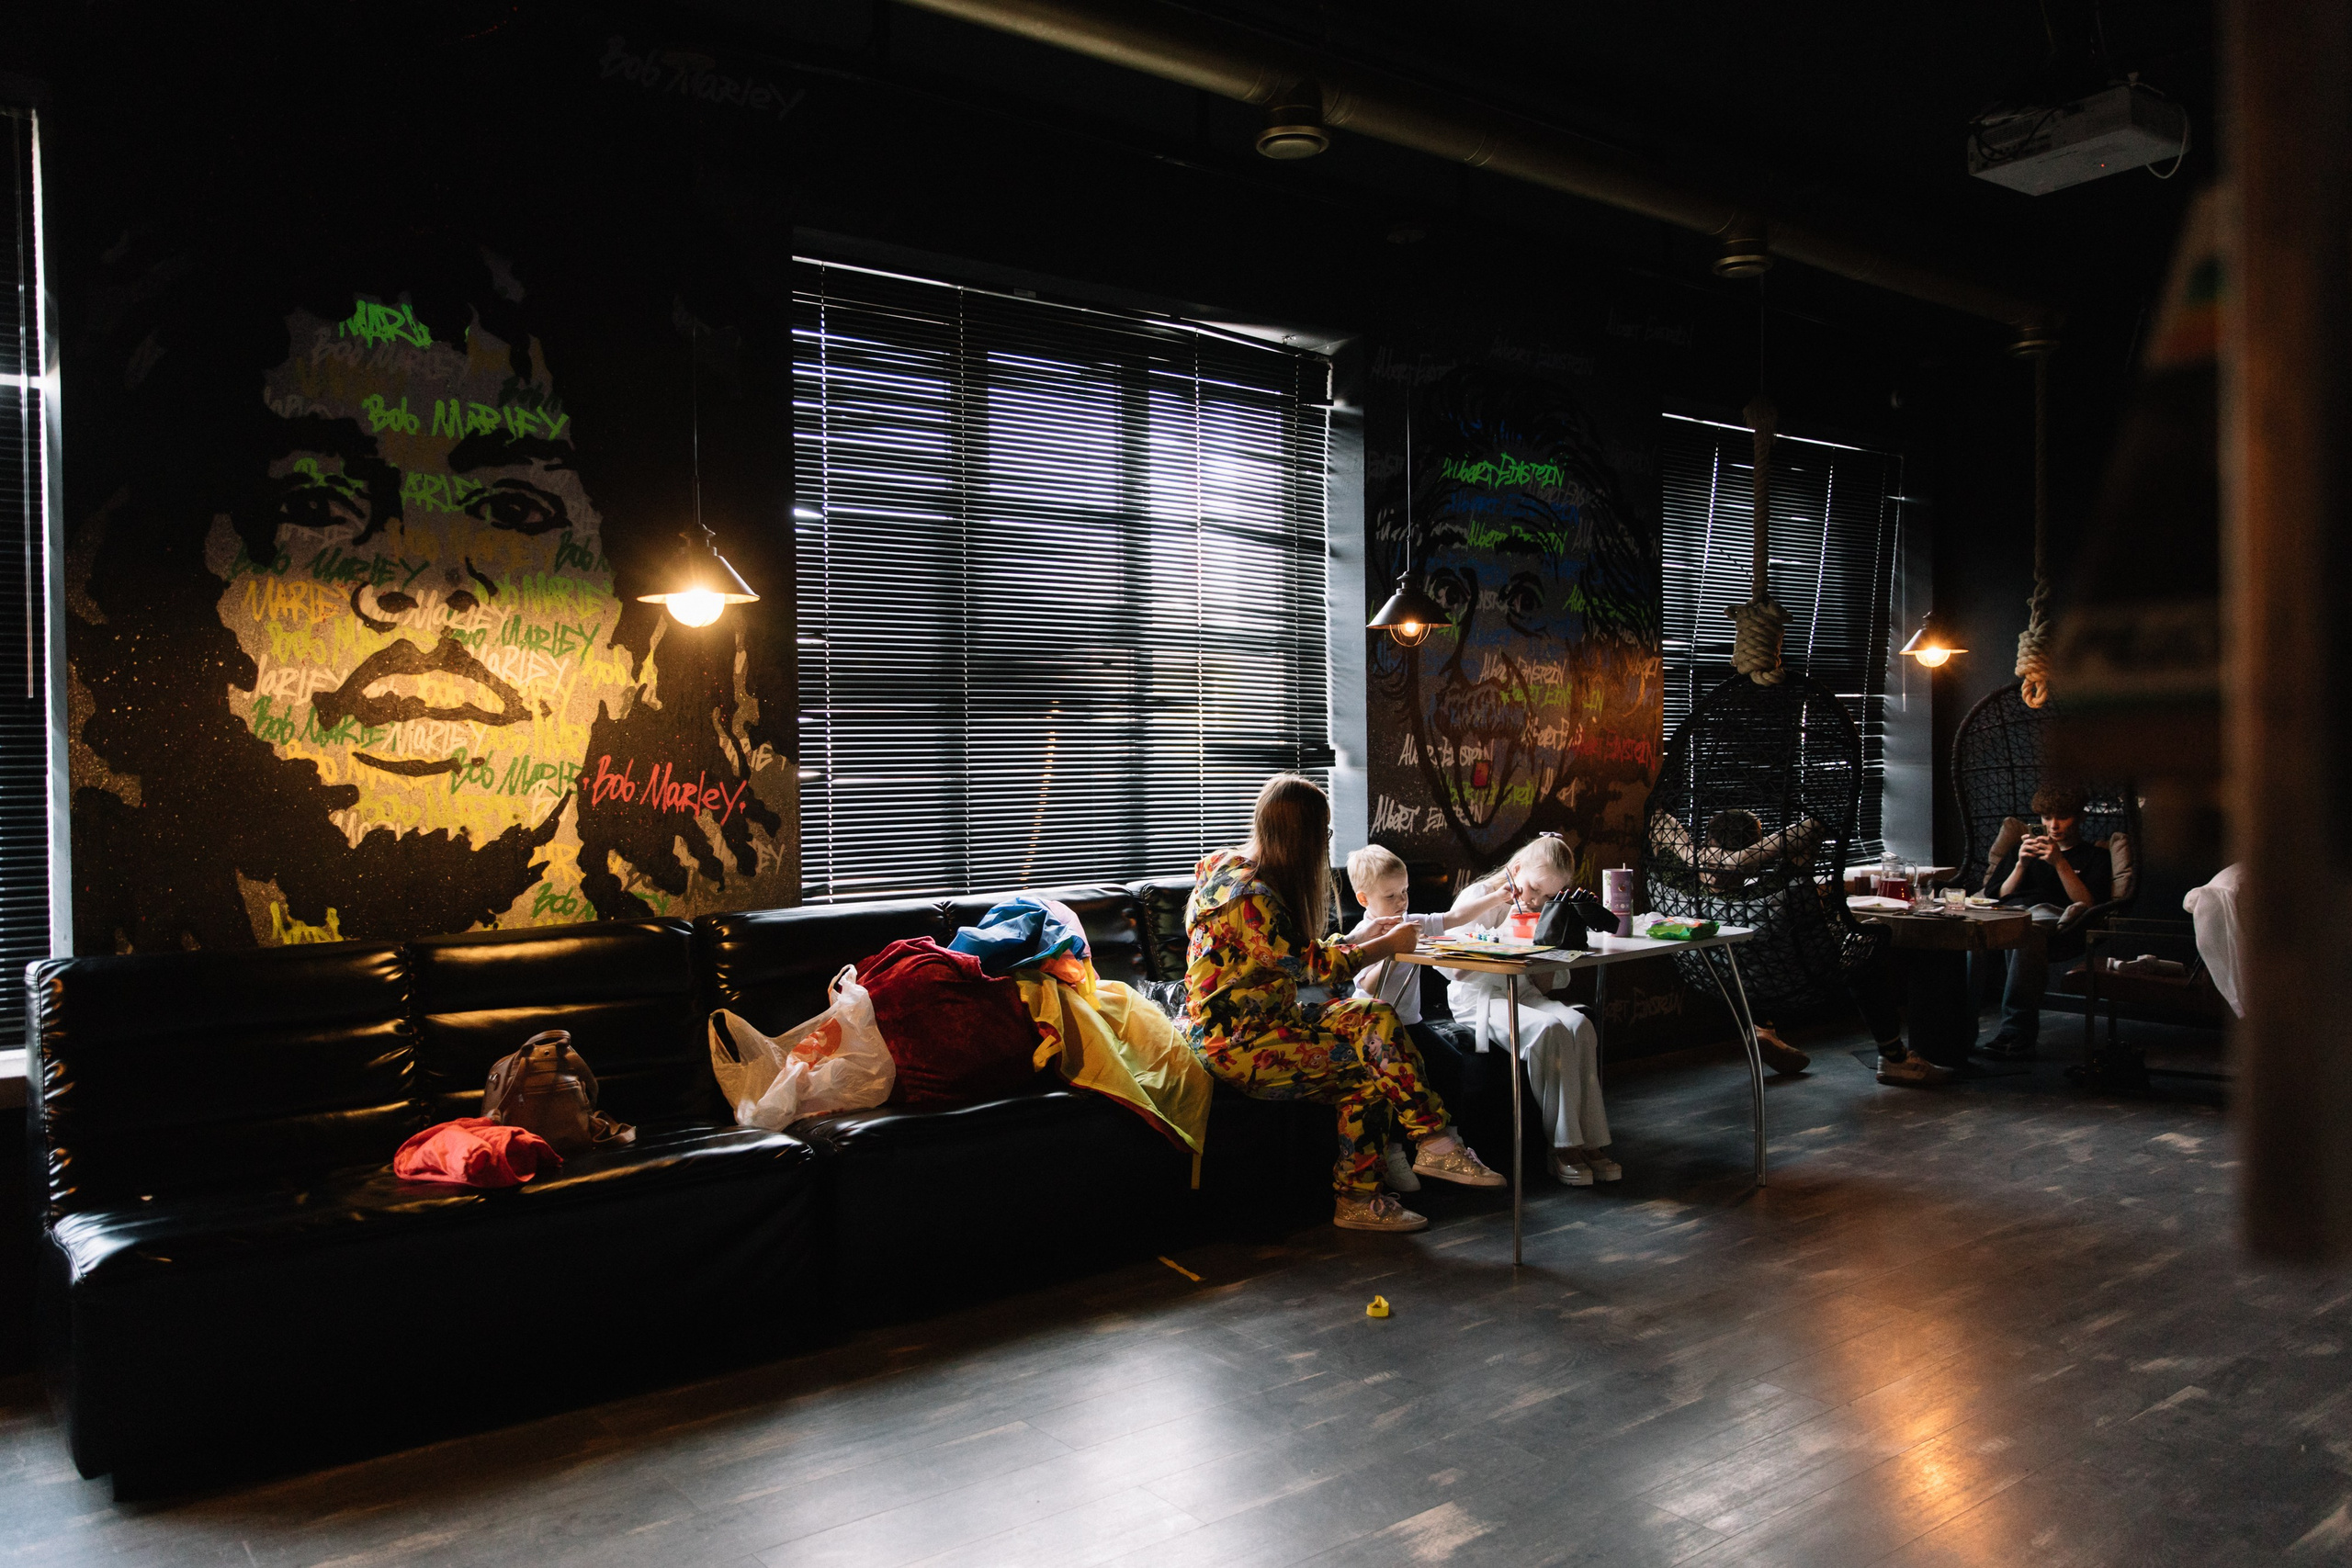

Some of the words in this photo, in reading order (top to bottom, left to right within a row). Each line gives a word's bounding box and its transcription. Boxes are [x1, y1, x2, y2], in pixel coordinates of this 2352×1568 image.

[599, 35, 662, 88] Bob
[362, 392, 421, 437] Bob
[502, 614, 602, 665] MARLEY
[253, 695, 295, 746] Bob
[379, 720, 487, 761] MARLEY
[450, 746, 495, 795] Bob
[591, 753, 637, 808] Bob
[532, 882, 582, 919] Bob
